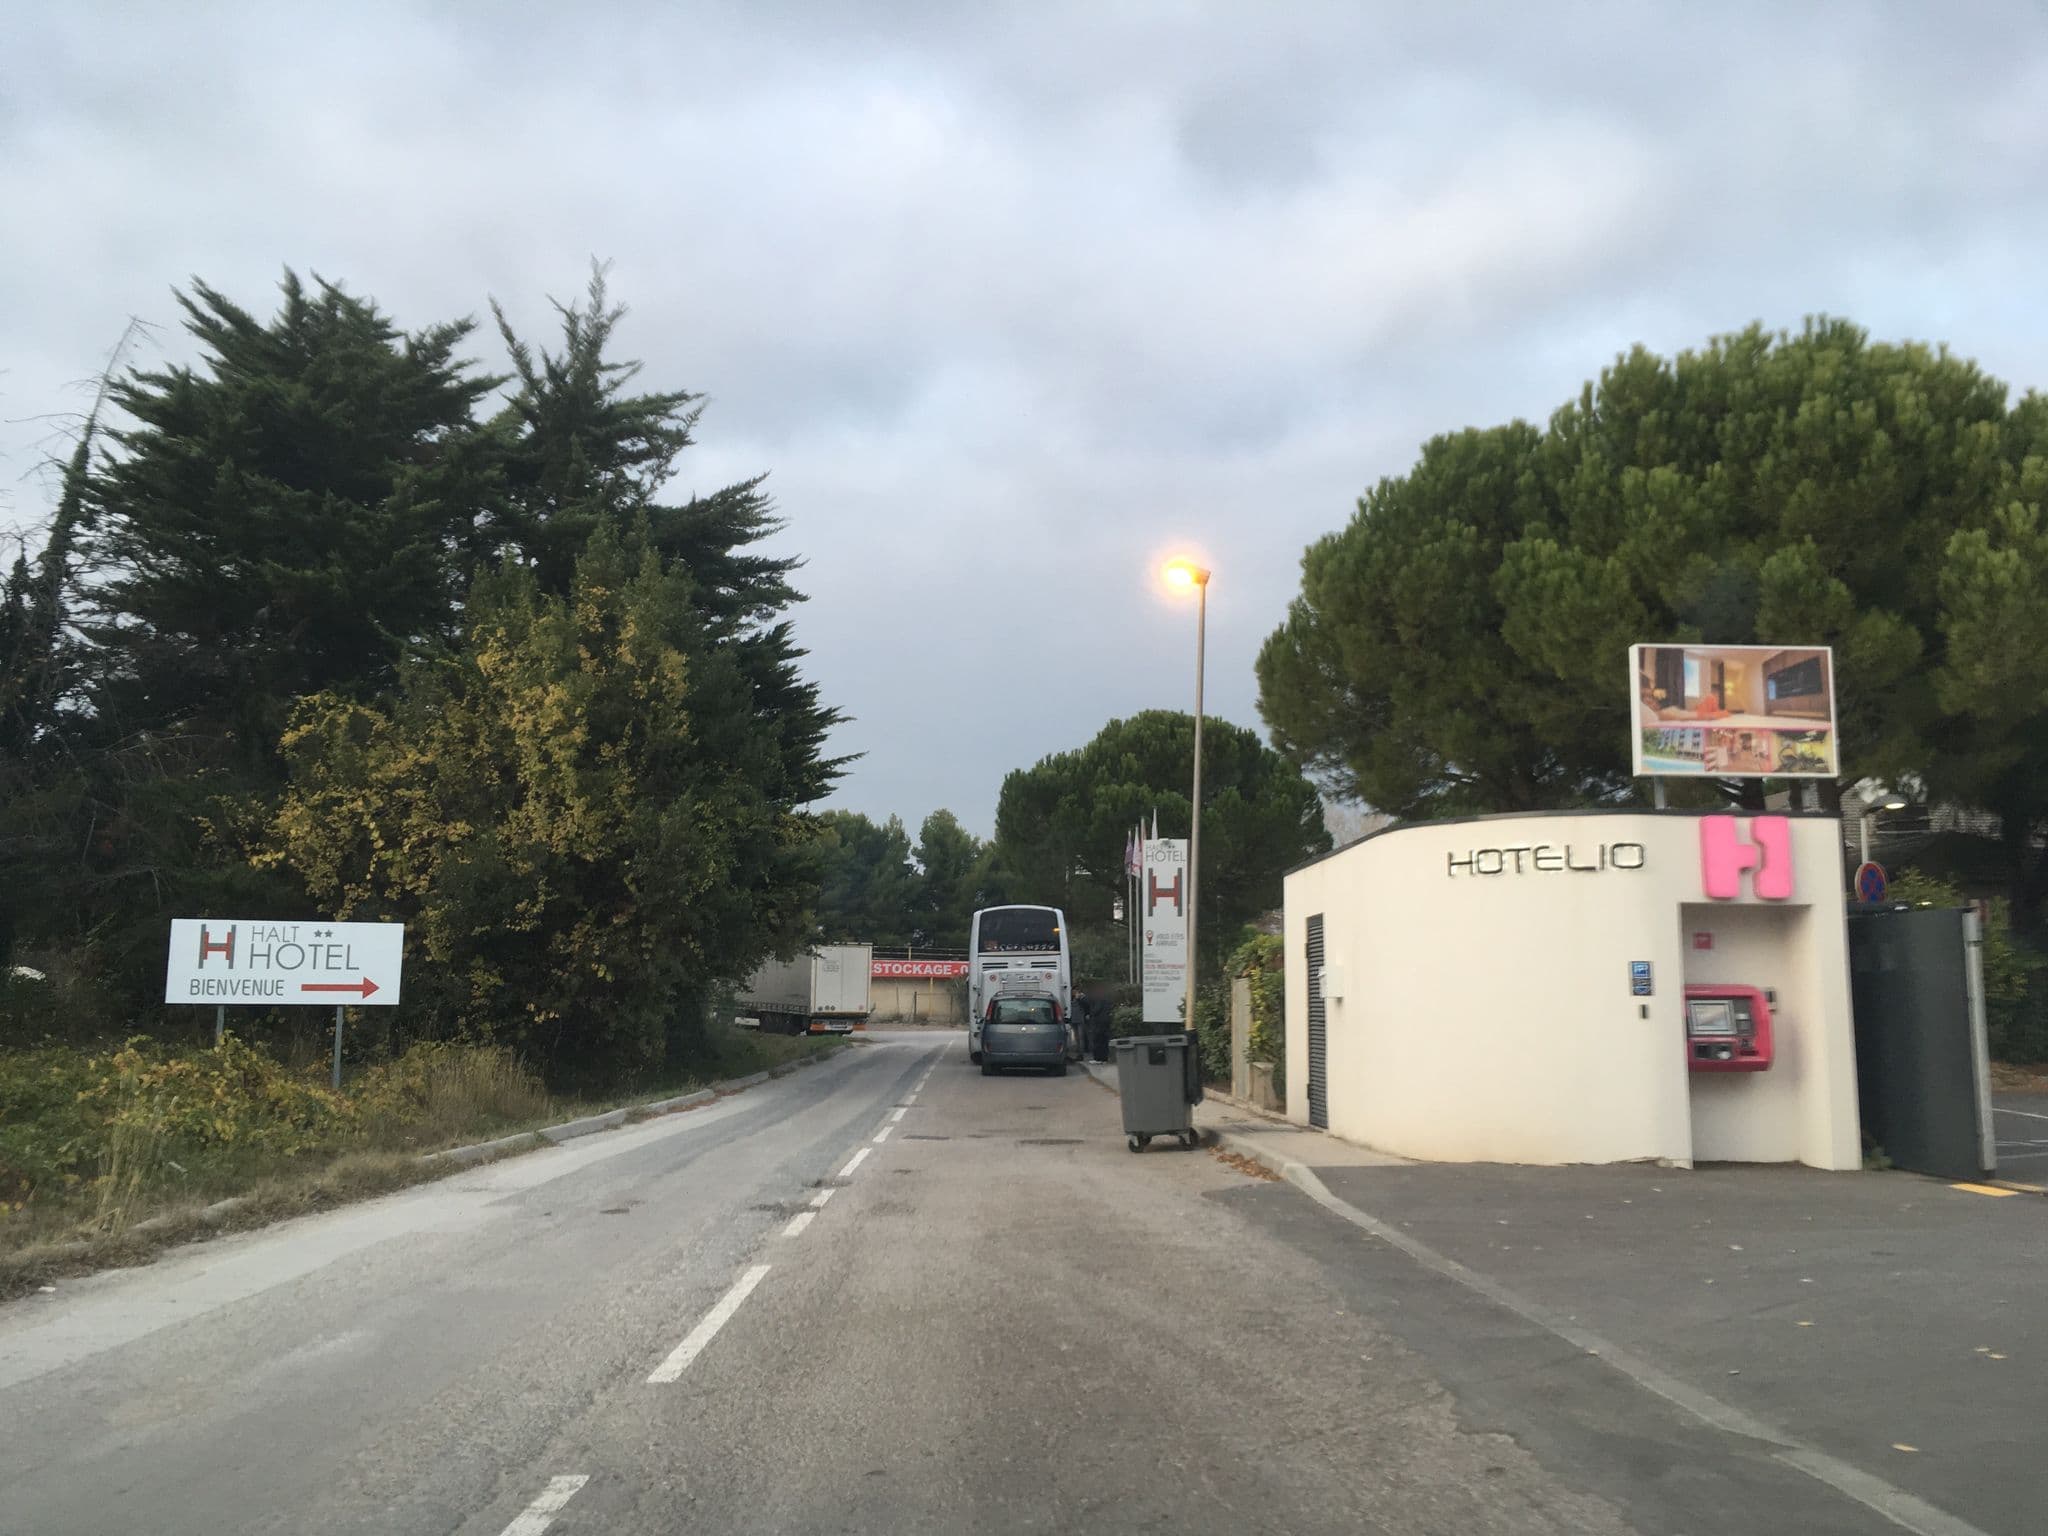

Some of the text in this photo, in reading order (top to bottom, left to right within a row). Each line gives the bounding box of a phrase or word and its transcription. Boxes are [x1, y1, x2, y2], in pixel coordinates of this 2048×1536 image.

[1146, 850, 1186, 862] HOTEL
[1447, 842, 1645, 877] HOTELIO
[251, 925, 300, 943] HALT
[249, 943, 360, 970] HOTEL
[872, 963, 952, 975] STOCKAGE
[189, 978, 285, 996] BIENVENUE
